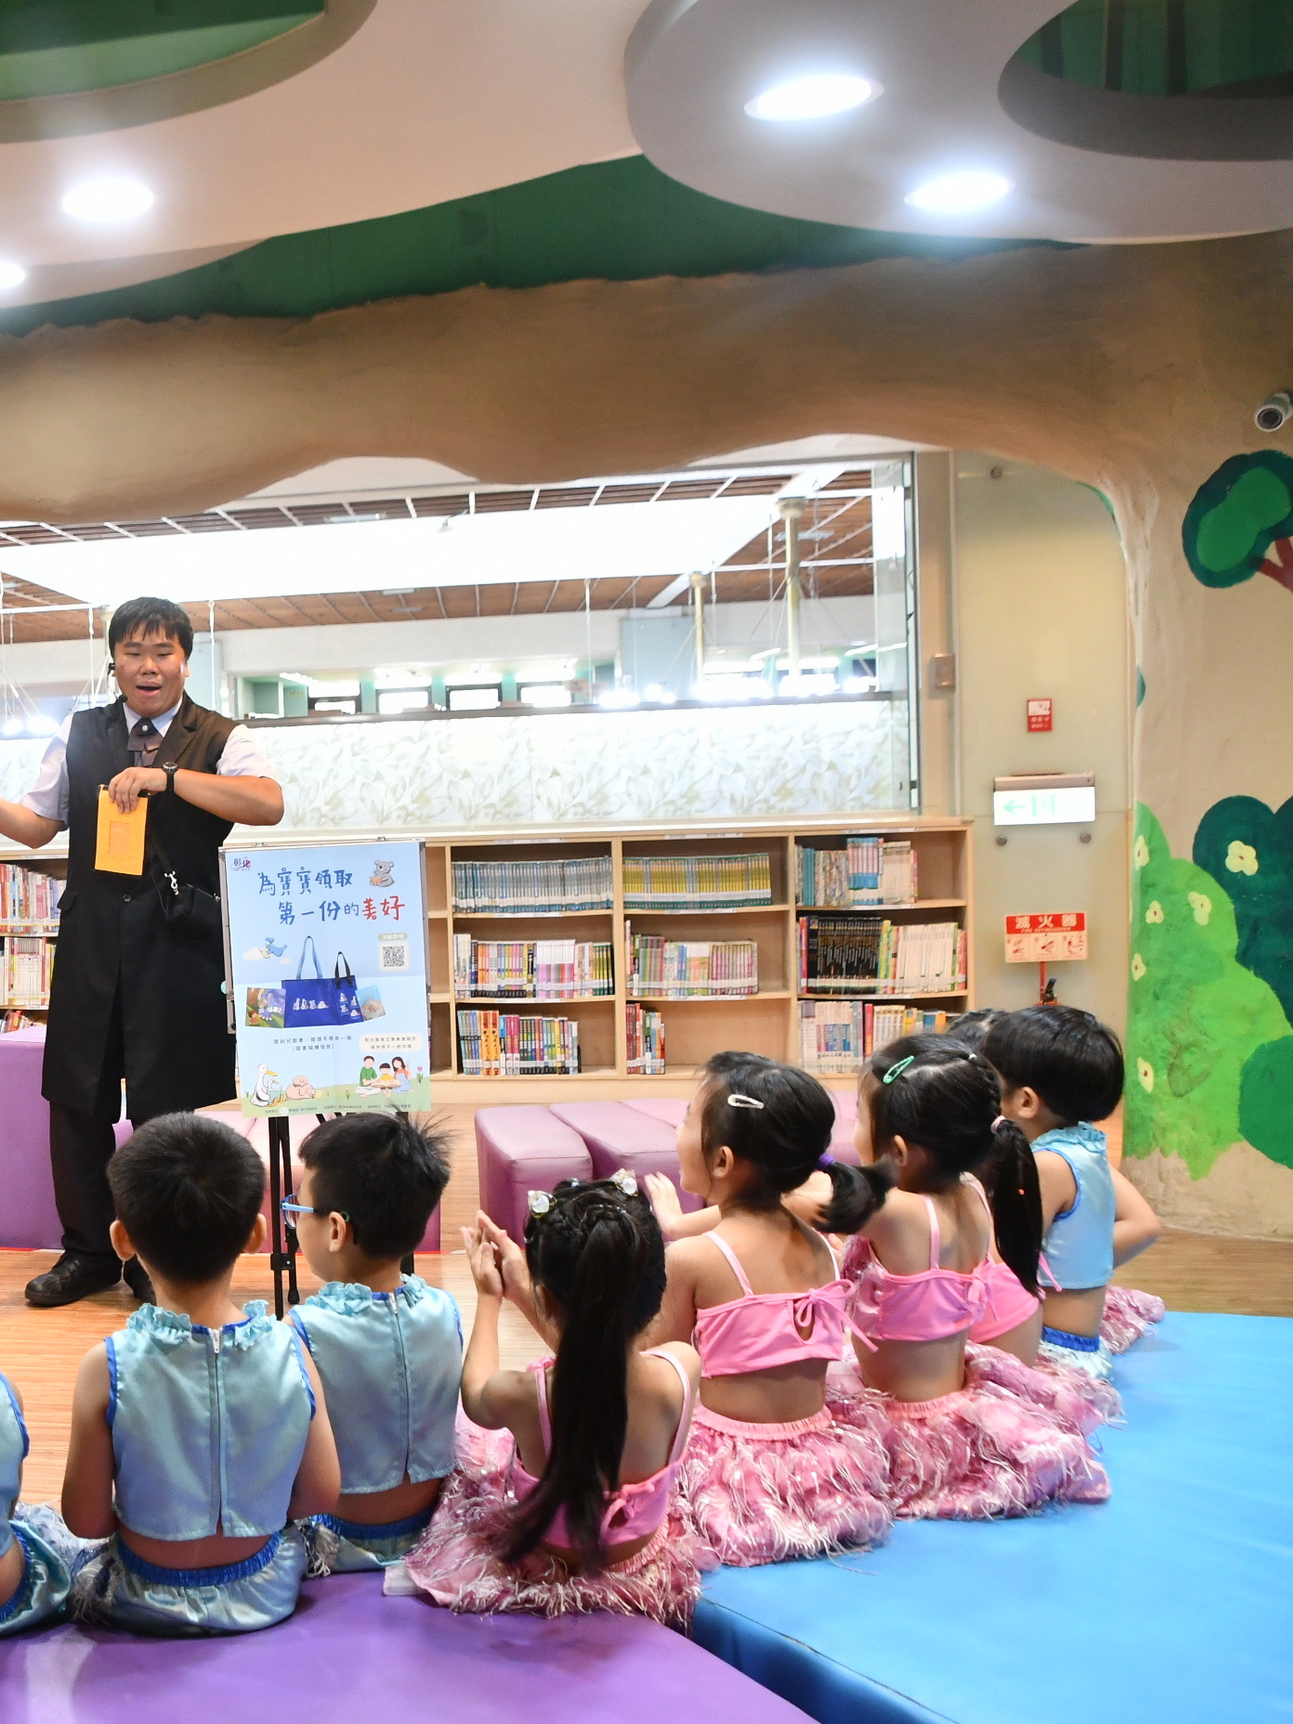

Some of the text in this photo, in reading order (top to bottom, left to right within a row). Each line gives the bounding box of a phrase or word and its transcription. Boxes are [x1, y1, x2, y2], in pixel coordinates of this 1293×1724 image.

[257, 866, 353, 896] 為寶寶領取
[278, 895, 406, 925] 第一份的美好
[1015, 913, 1077, 929] 滅火器
